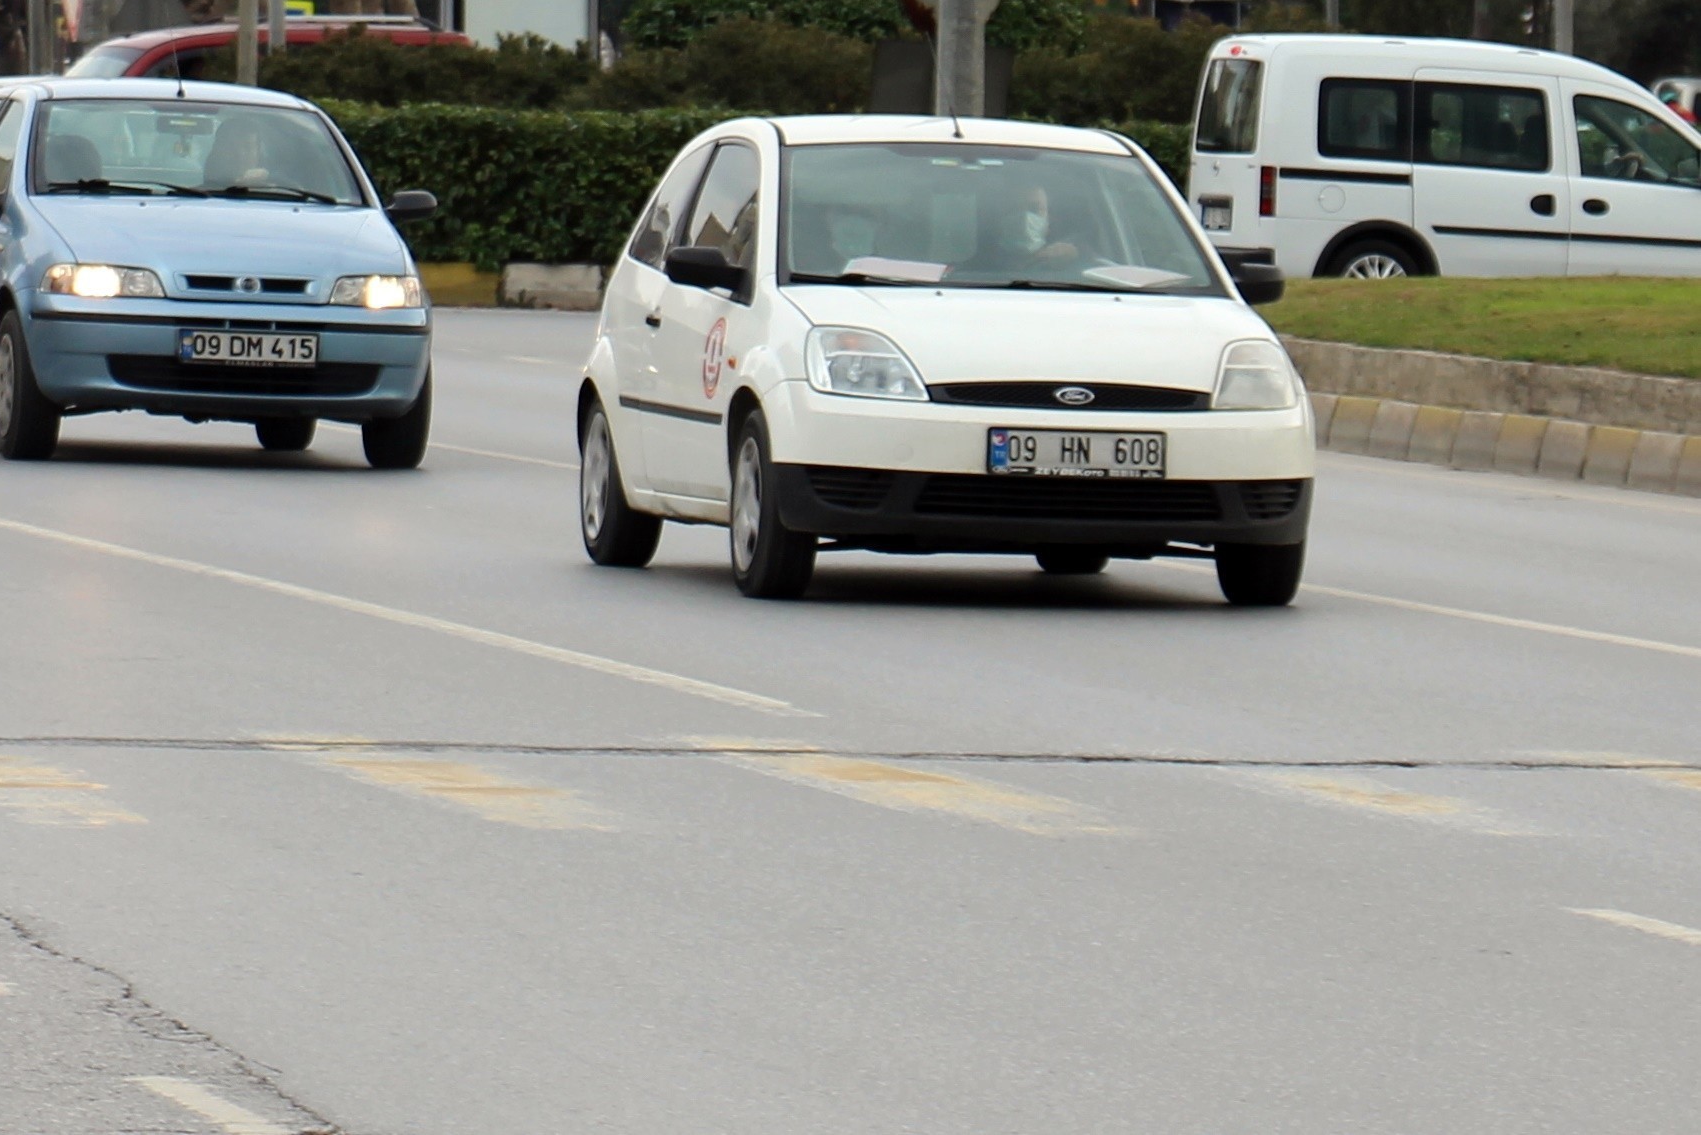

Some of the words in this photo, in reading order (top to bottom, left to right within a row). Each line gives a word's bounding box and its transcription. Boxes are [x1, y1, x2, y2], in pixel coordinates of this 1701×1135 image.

[193, 334, 221, 356] 09
[229, 335, 264, 358] DM
[271, 337, 314, 360] 415
[1009, 435, 1037, 462] 09
[1061, 436, 1091, 464] HN
[1114, 437, 1160, 465] 608
